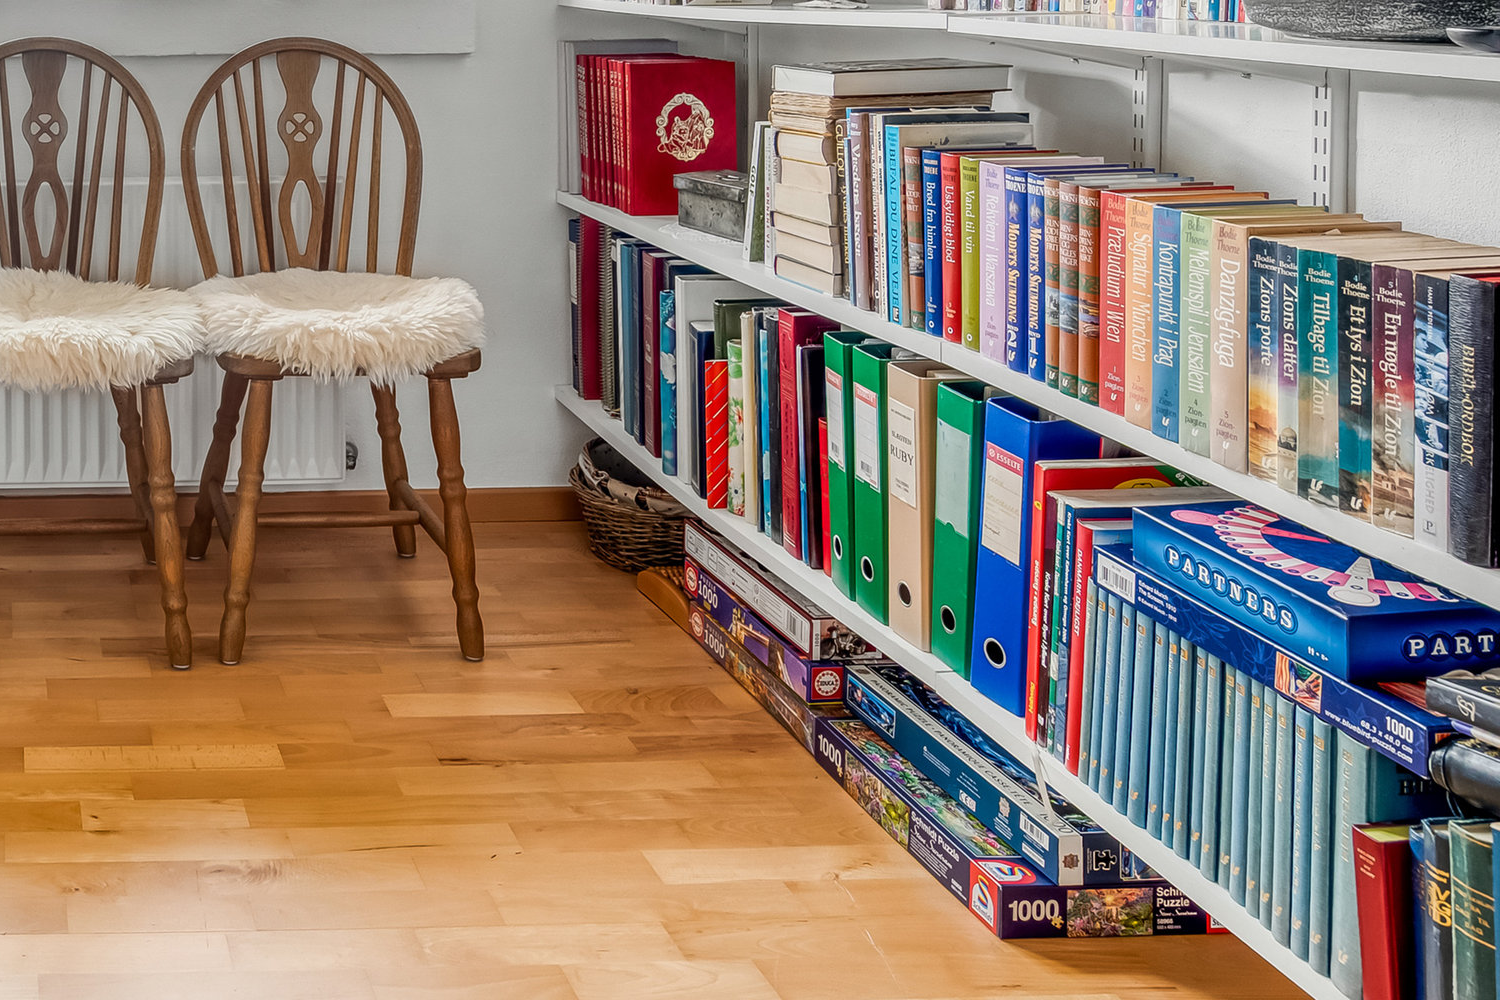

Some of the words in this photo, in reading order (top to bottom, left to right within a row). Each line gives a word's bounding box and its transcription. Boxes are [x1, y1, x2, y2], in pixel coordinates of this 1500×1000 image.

[835, 124, 844, 178] GUILLOU
[888, 149, 897, 196] BEFAL
[925, 181, 936, 206] Brød
[965, 190, 975, 217] Vand
[890, 201, 898, 219] DU
[926, 208, 935, 223] fra
[943, 185, 955, 235] Uskyldigt
[986, 195, 999, 240] Rekviem
[965, 219, 975, 232] til
[1219, 226, 1237, 240] Bodie
[927, 224, 935, 261] himlen
[946, 236, 956, 263] blod
[966, 234, 975, 254] vin
[1217, 239, 1240, 255] Thoene
[1107, 225, 1125, 301] Præludium
[1127, 232, 1151, 288] Signatur
[1252, 261, 1278, 271] Thoene
[1255, 254, 1275, 264] Bodie
[986, 250, 999, 307] Warszawa
[1154, 240, 1178, 321] Kontrapunkt
[1183, 247, 1209, 315] Mellemspil
[1304, 274, 1335, 286] Thoene
[1308, 267, 1332, 279] Bodie
[1344, 280, 1367, 292] Bodie
[892, 272, 900, 309] VEJE
[1260, 275, 1274, 321] Zions
[1341, 287, 1370, 300] Thoene
[1375, 294, 1406, 307] Thoene
[1379, 287, 1403, 299] Bodie
[1213, 257, 1241, 369] Danzig-fuga
[1283, 282, 1298, 329] Zions
[1350, 305, 1366, 327] Et
[1107, 310, 1125, 343] Wien
[1131, 298, 1151, 362] München
[1307, 292, 1330, 354] Tilbage
[1384, 311, 1402, 333] En
[1007, 329, 1017, 349] 2
[1154, 332, 1178, 368] Prag
[1260, 323, 1272, 367] porte
[1350, 329, 1366, 355] lys
[1187, 325, 1208, 394] Jerusalem
[1283, 331, 1298, 381] datter
[1313, 356, 1329, 375] til
[1379, 335, 1402, 389] nøgle
[1312, 377, 1329, 415] Zion
[1350, 365, 1367, 406] Zion
[1187, 407, 1203, 418] Zion-
[1385, 392, 1402, 410] til
[1184, 416, 1207, 429] pagten
[1216, 429, 1238, 442] pagten
[1385, 412, 1402, 456] Zion
[890, 444, 914, 466] RUBY
[996, 453, 1021, 472] ESSELTE
[698, 580, 718, 609] 1000
[1138, 587, 1147, 596] The
[1154, 587, 1169, 600] Munch
[1168, 547, 1293, 630] PARTNERS
[704, 629, 725, 659] 1000
[906, 703, 933, 728] PUZZLE
[1386, 715, 1414, 743] 1000
[818, 734, 842, 766] 1000
[1325, 709, 1413, 764] www.bluebird-puzzle.com
[1360, 720, 1377, 733] 68.3
[1402, 744, 1413, 754] cm
[911, 811, 937, 841] Schmidt
[937, 837, 960, 863] Puzzle
[972, 901, 993, 925] Schmidt
[1008, 899, 1059, 922] 1000
[1156, 897, 1190, 907] Puzzle
